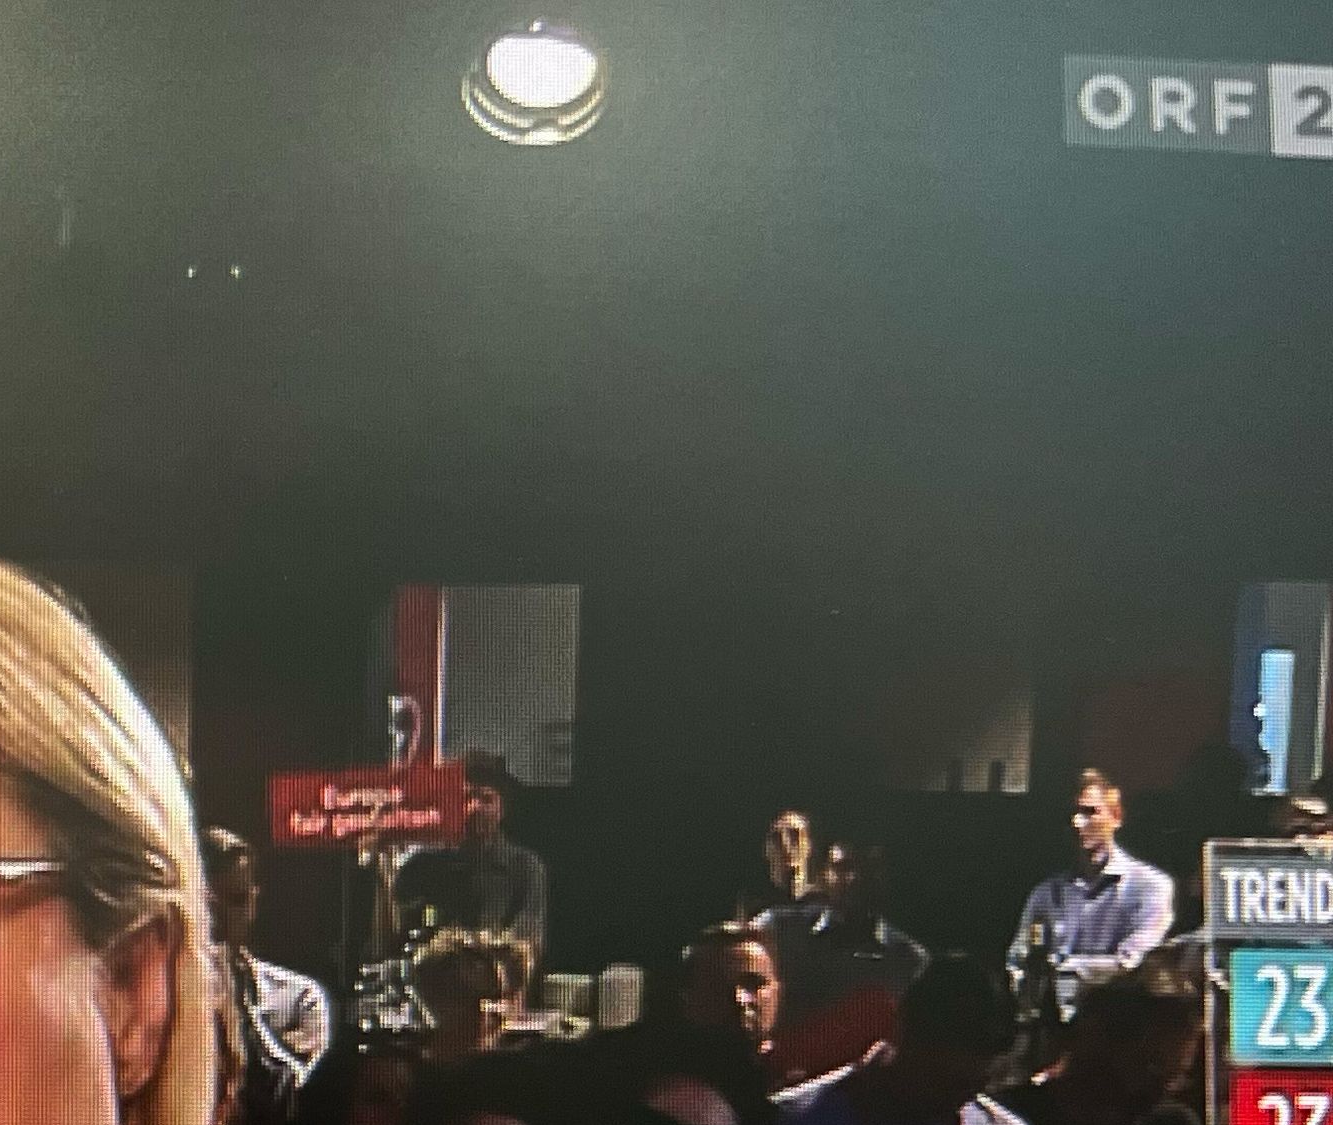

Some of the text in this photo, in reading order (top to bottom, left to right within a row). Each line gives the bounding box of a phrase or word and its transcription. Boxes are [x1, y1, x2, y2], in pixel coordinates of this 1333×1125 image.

[1078, 74, 1333, 136] ORF 2
[1220, 867, 1333, 923] TREND
[1256, 964, 1331, 1048] 23
